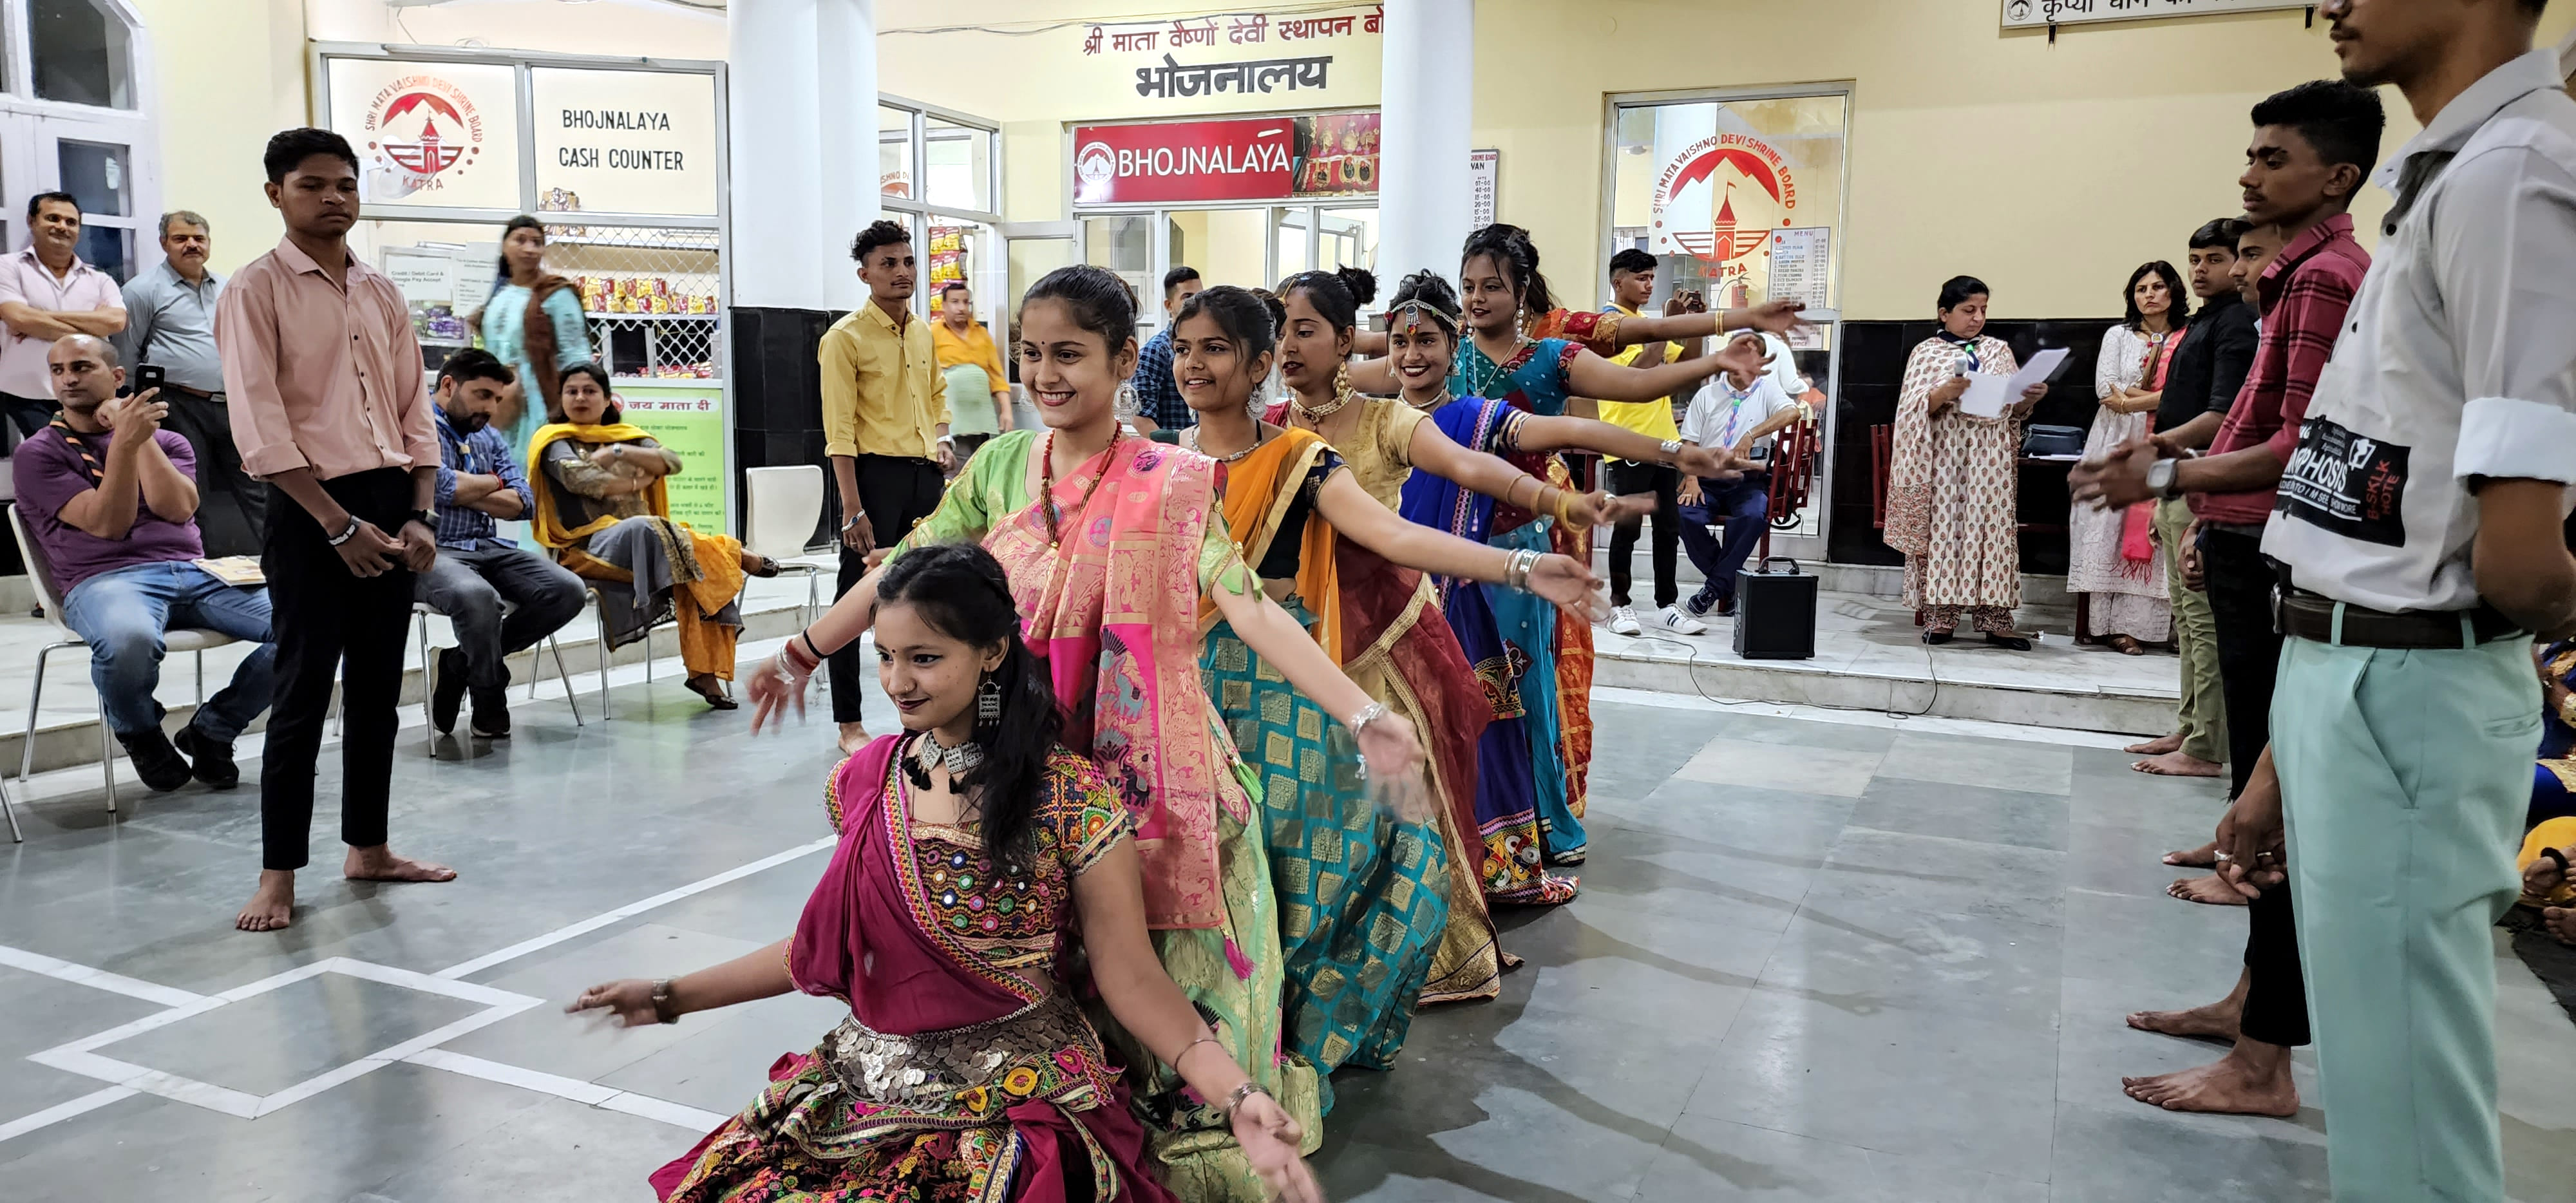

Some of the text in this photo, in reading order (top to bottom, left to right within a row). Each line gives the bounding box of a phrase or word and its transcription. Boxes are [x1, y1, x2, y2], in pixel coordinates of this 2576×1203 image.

[1083, 23, 1103, 55] श्री
[1112, 31, 1159, 52] माता
[1228, 14, 1269, 45] देवी
[1278, 15, 1356, 41] स्थापन
[1135, 53, 1333, 98] भोजनालय
[365, 75, 482, 142] SHRI MATA VAISHNO DEVI SHRINE BOARD
[562, 109, 670, 131] BHOJNALAYA
[559, 147, 684, 171] CASH COUNTER
[1119, 143, 1290, 177] BHOJNALAYA
[1659, 166, 1679, 188] MATA
[1675, 136, 1717, 166] VAISHNO
[1721, 134, 1746, 145] DEVI
[1747, 138, 1782, 167] SHRINE
[1778, 166, 1795, 209] BOARD
[402, 175, 443, 191] KATRA
[1698, 263, 1747, 278] KATRA
[629, 399, 711, 412] जय माता दी
